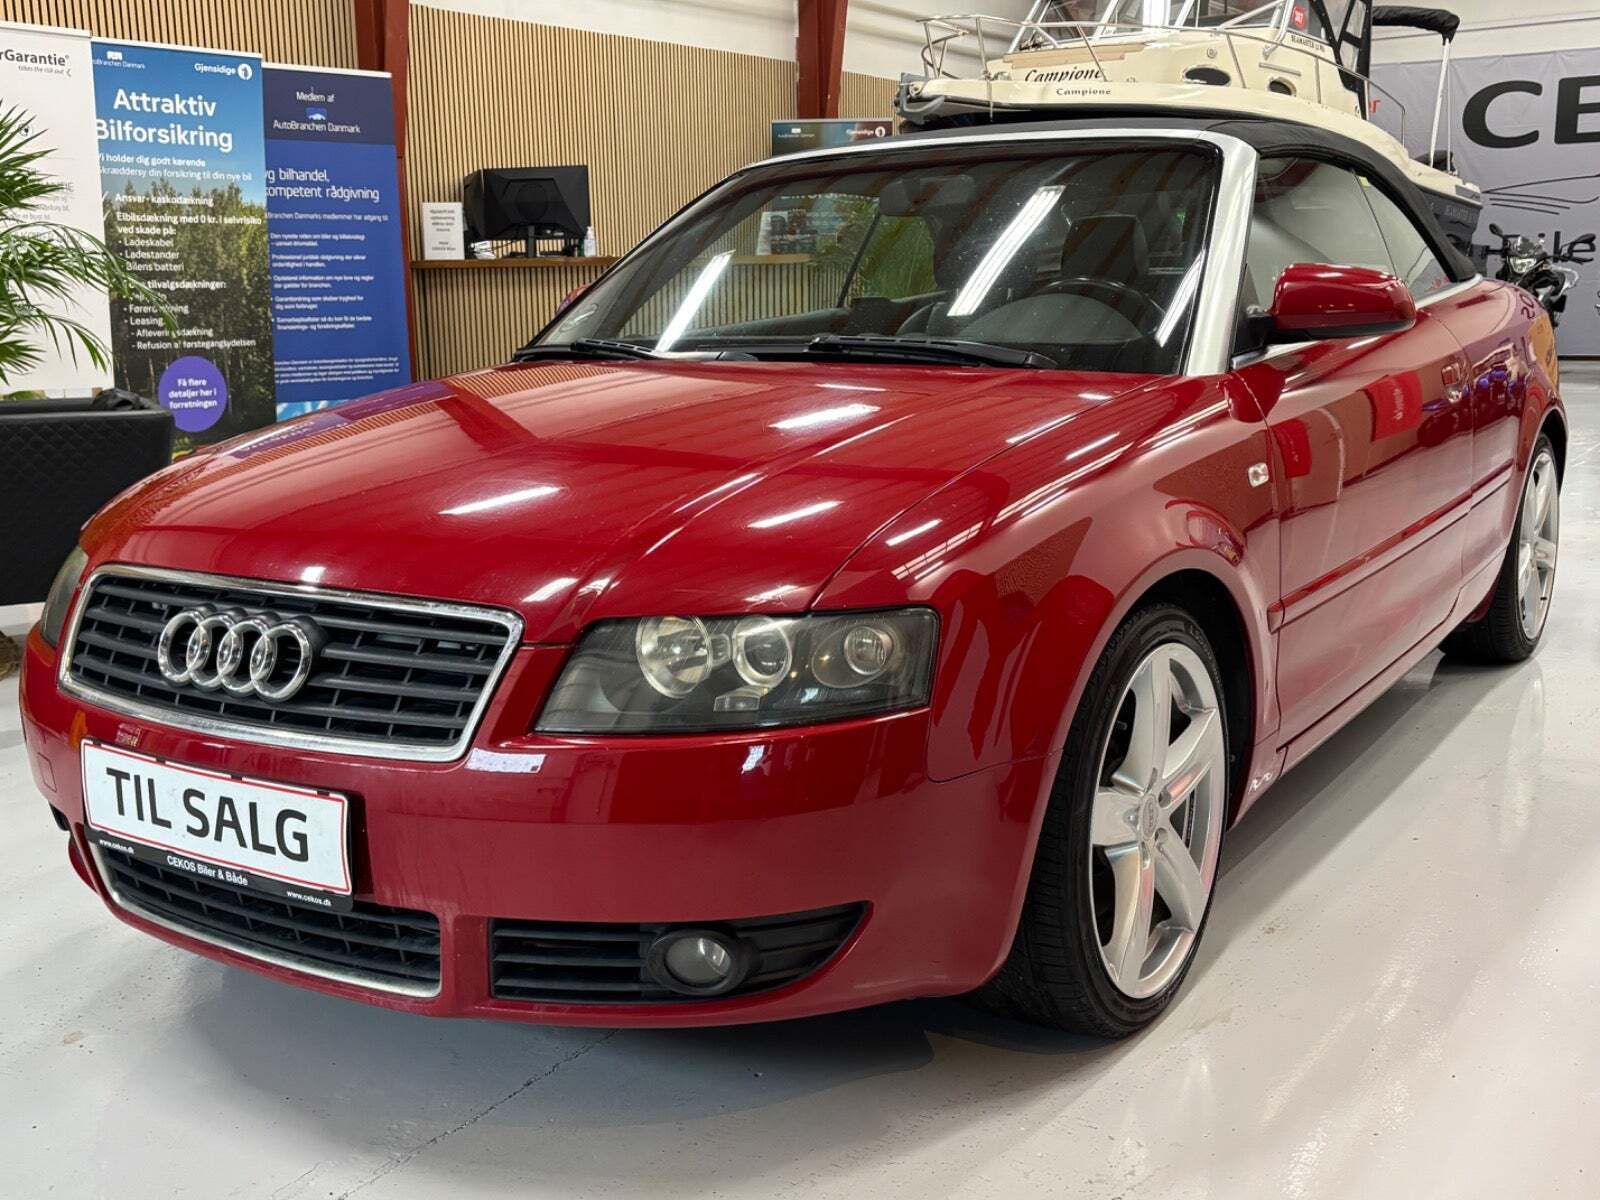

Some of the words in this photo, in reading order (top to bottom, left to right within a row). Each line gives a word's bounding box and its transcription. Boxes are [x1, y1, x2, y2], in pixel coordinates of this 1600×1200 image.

[194, 63, 236, 75] Gjensidige
[1025, 66, 1103, 83] Campione
[296, 91, 326, 102] Medlem
[327, 94, 336, 103] af
[1056, 88, 1111, 97] Campione
[114, 88, 217, 117] Attraktiv
[1462, 75, 1600, 149] CE
[273, 120, 327, 132] AutoBranchen
[328, 122, 361, 134] Danmark
[96, 118, 233, 153] Bilforsikring
[106, 153, 135, 164] holder
[136, 155, 150, 167] dig
[151, 157, 171, 167] godt
[172, 158, 206, 167] kørende
[148, 169, 162, 177] din
[163, 168, 201, 180] forsikring
[202, 170, 211, 179] til
[212, 170, 226, 180] din
[227, 173, 241, 182] nye
[242, 172, 253, 181] bil
[279, 168, 330, 183] bilhandel,
[265, 186, 322, 200] ompetent
[326, 185, 380, 203] rådgivning
[179, 214, 199, 224] med
[118, 224, 134, 234] ved
[135, 225, 161, 235] skade
[162, 225, 177, 237] på:
[124, 237, 174, 247] Ladeskabel
[125, 249, 180, 260] Ladestander
[126, 262, 152, 272] Bilens
[154, 262, 185, 272] batteri
[130, 317, 164, 327] Leasing
[137, 340, 171, 350] Refusion
[177, 378, 187, 387] Få
[188, 378, 207, 386] flere
[168, 388, 198, 399] detaljer
[200, 388, 213, 396] her
[169, 399, 218, 409] forretningen
[106, 767, 172, 829] TIL
[182, 788, 309, 863] SALG
[167, 855, 196, 873] CEKOS
[197, 863, 216, 879] Biler
[217, 868, 225, 880] &
[226, 869, 249, 887] Både
[286, 889, 332, 907] www.cekos.dk
